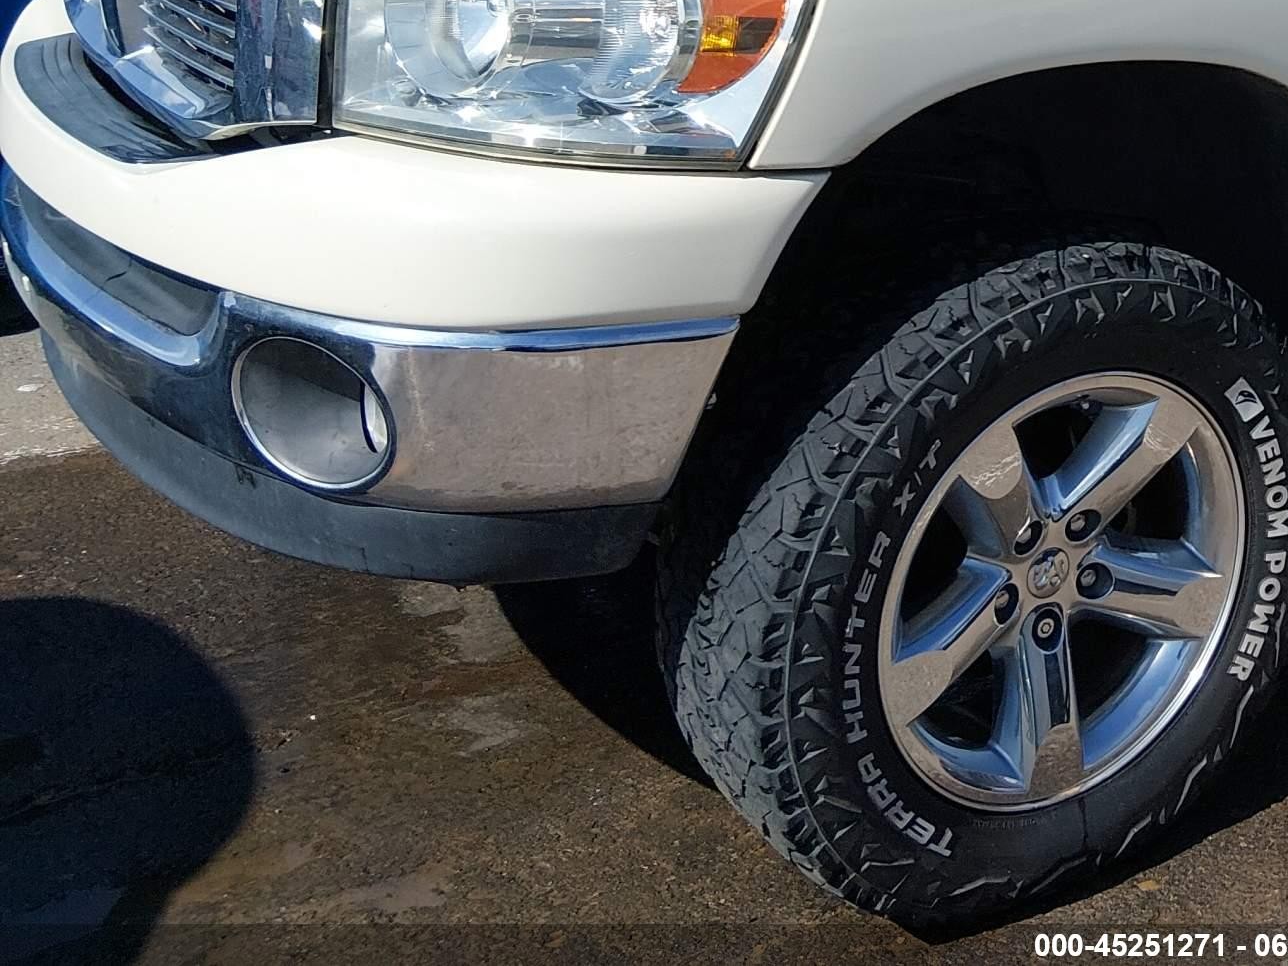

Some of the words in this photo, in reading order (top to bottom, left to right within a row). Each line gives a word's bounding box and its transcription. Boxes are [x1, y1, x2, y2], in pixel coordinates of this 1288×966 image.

[892, 438, 942, 517] X/T
[1249, 415, 1288, 538] VENOM
[841, 531, 892, 745] HUNTER
[1227, 550, 1287, 683] POWER
[857, 752, 954, 857] TERRA
